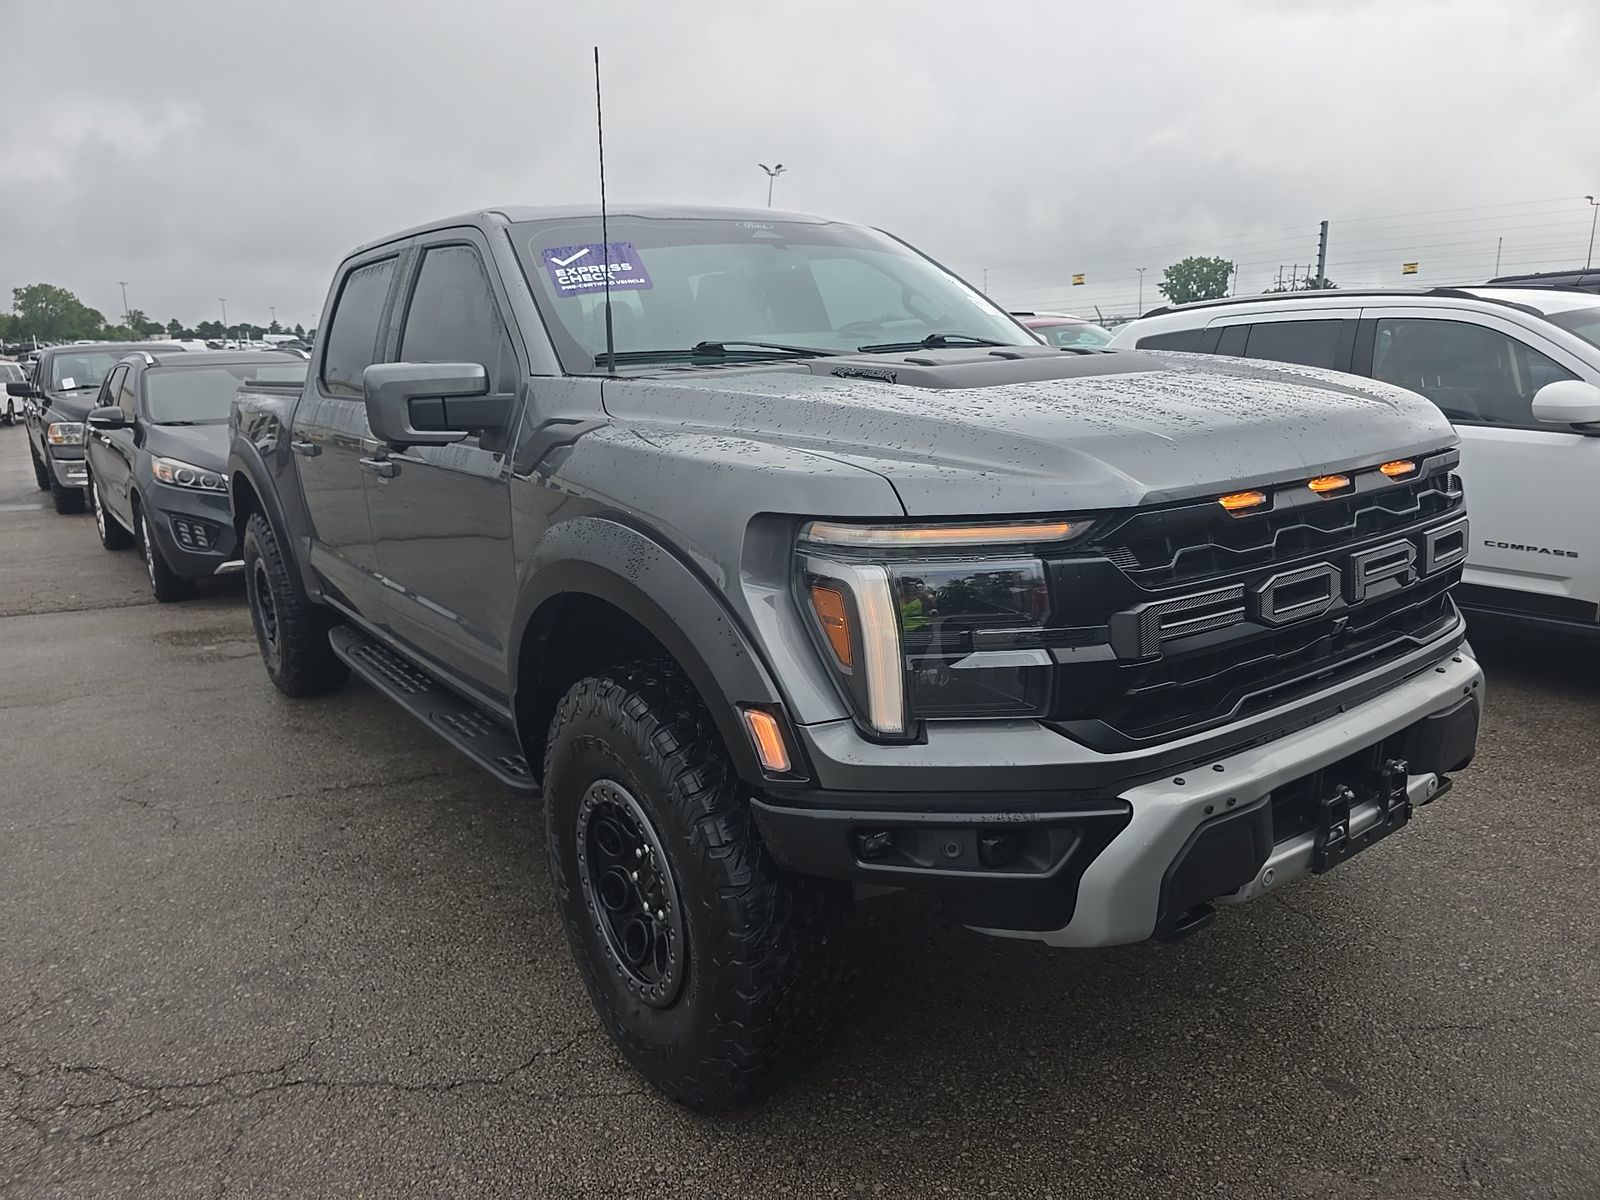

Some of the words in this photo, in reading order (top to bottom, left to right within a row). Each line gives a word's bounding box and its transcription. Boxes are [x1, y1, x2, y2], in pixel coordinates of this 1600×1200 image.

[555, 263, 632, 277] EXPRESS
[558, 272, 615, 285] CHECK
[832, 366, 897, 384] RAPTOR
[1484, 540, 1579, 558] COMPASS
[1120, 518, 1469, 660] FORD
